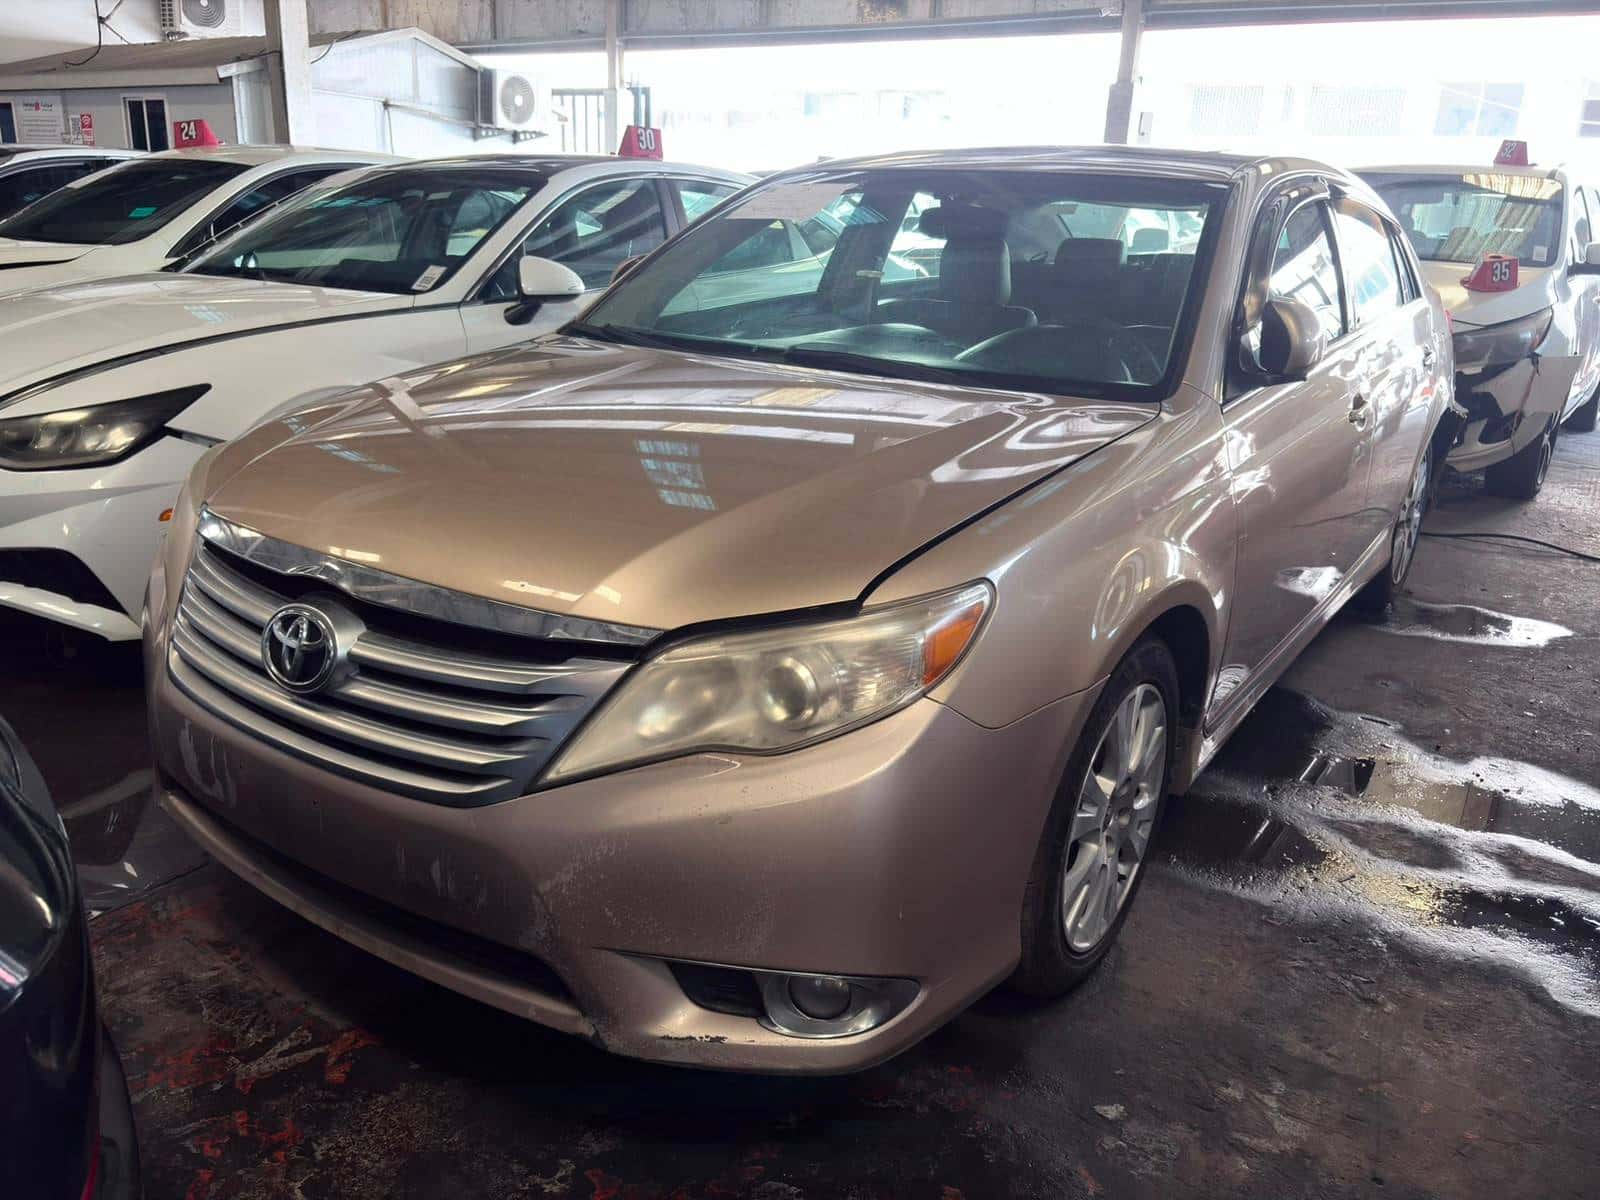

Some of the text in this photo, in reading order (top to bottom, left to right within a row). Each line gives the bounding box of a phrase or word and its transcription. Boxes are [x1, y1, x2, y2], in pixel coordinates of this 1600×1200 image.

[180, 121, 197, 141] 24
[638, 128, 656, 150] 30
[1492, 261, 1511, 282] 35
